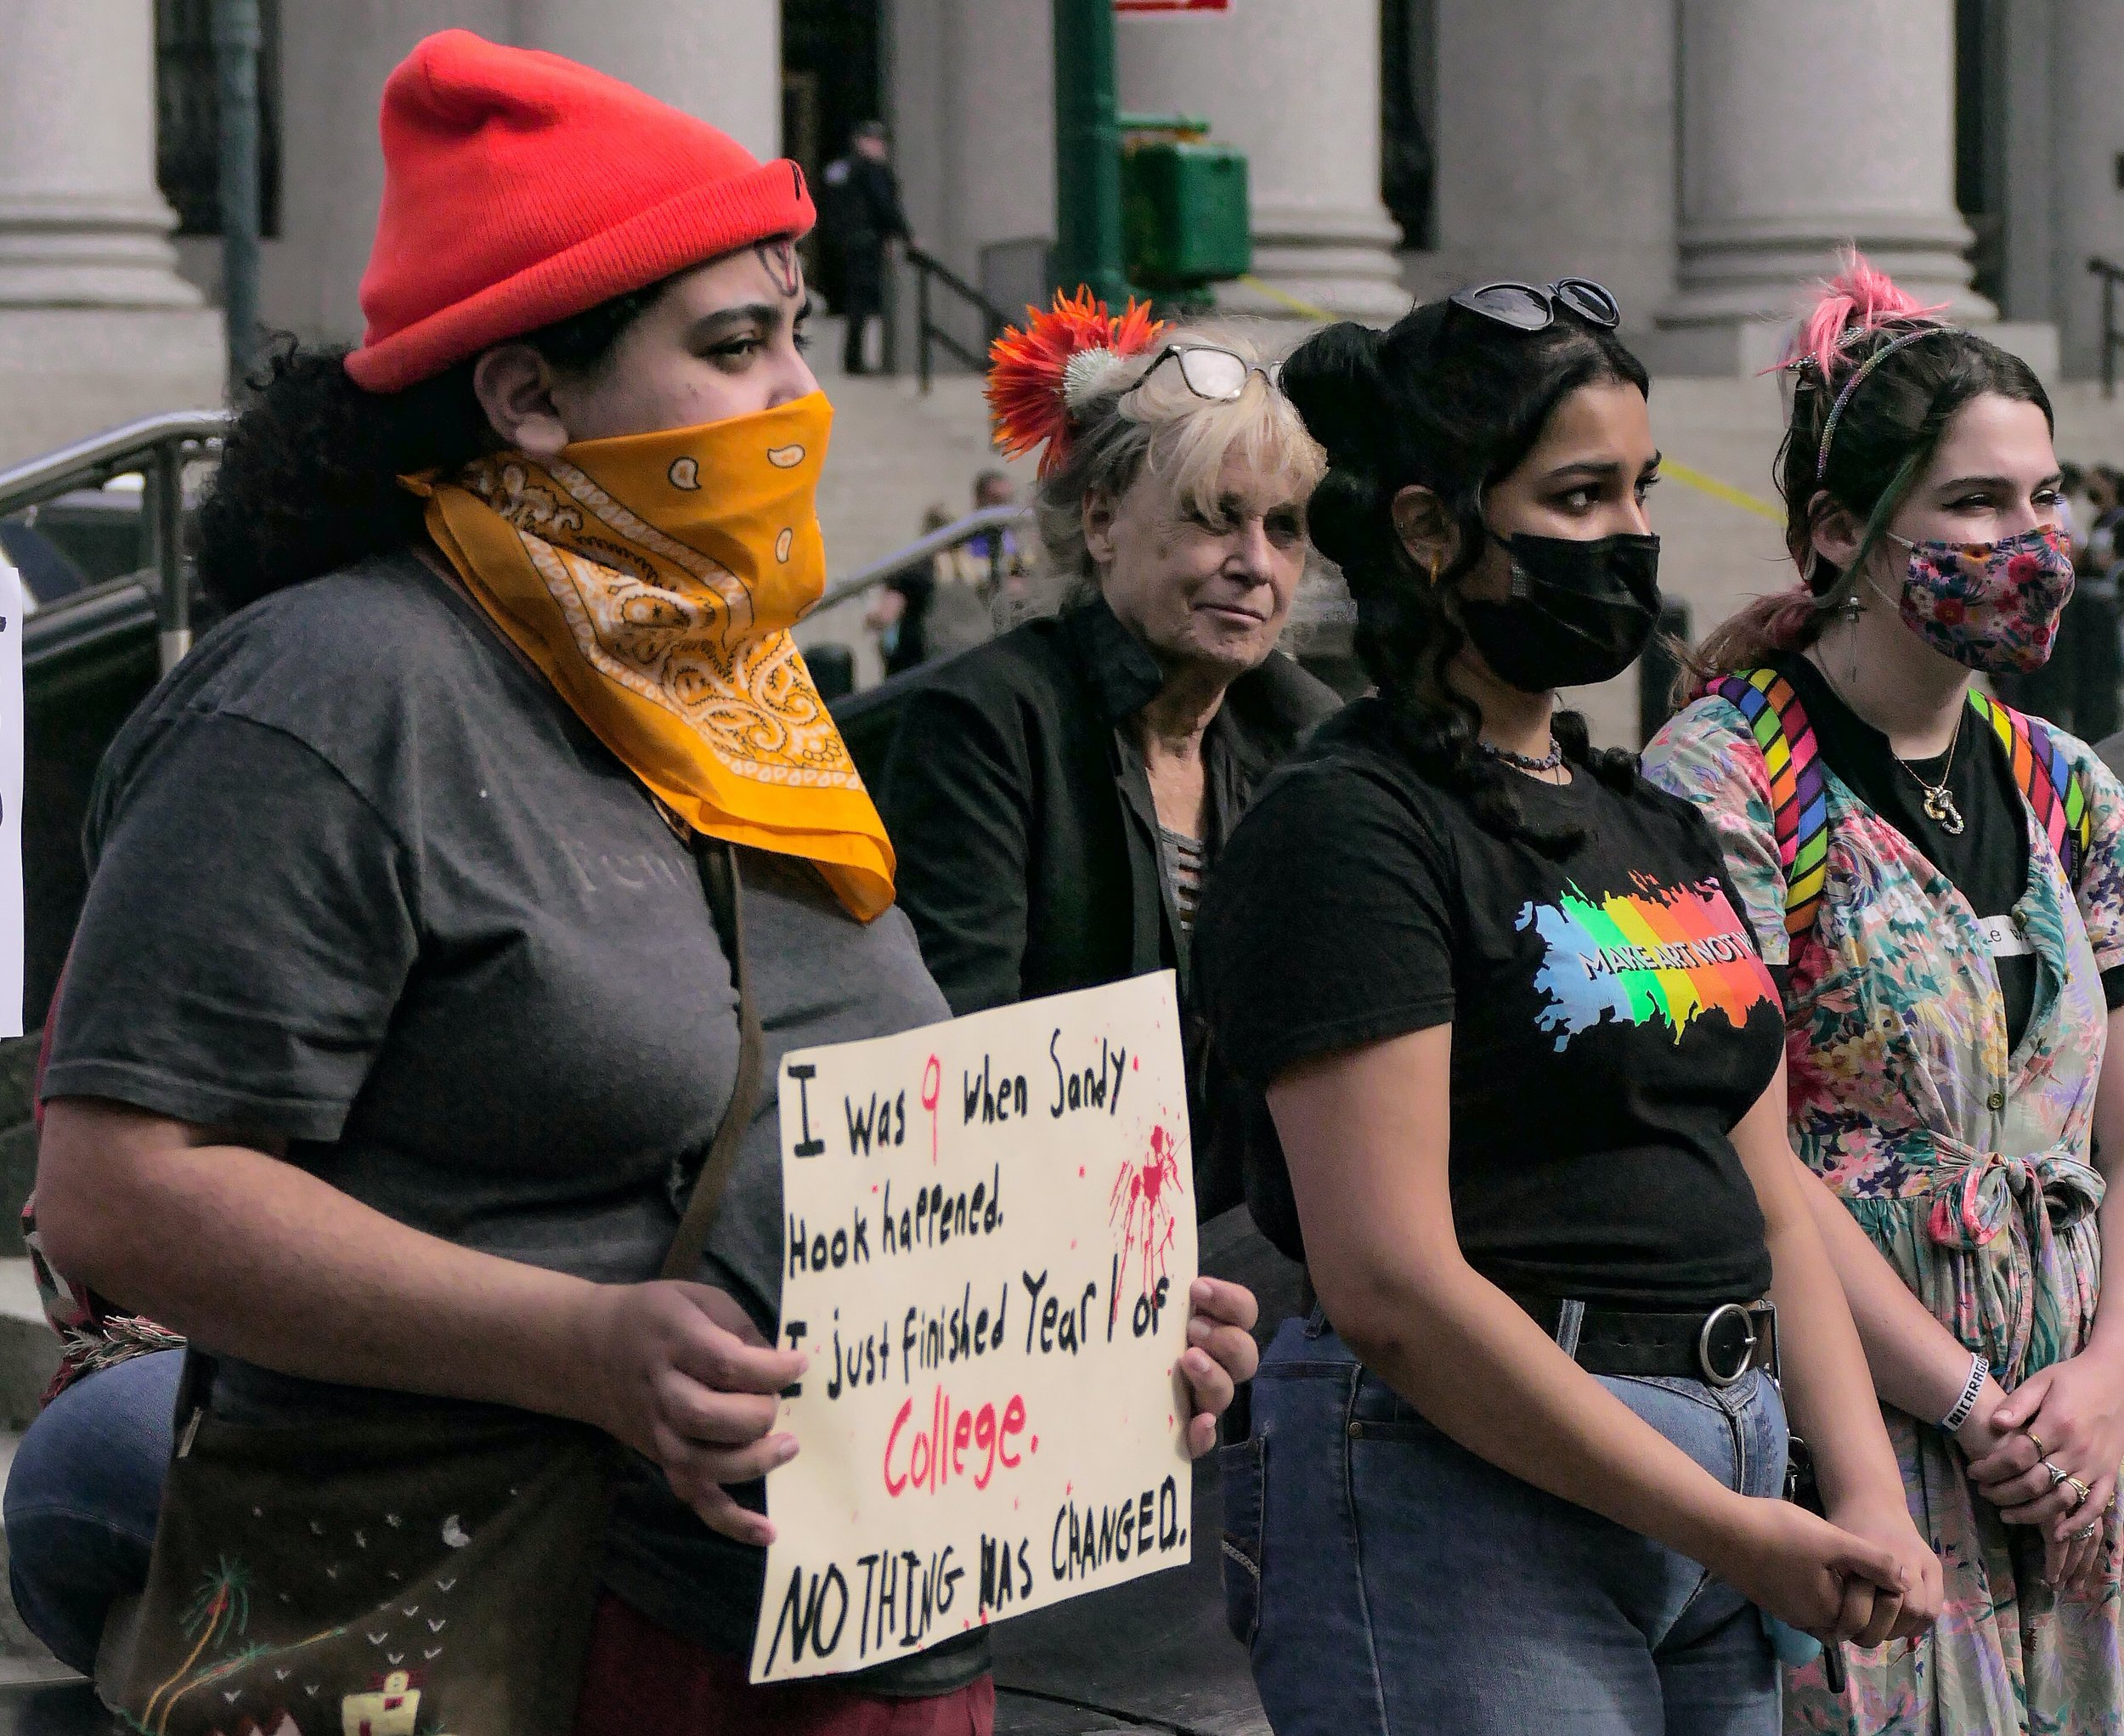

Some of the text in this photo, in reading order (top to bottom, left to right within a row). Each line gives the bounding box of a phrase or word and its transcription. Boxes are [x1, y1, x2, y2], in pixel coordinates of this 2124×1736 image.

[1578, 945, 1662, 981] MAKE
[1653, 942, 1700, 970] ART
[1690, 932, 1747, 965] NOT
[787, 1064, 826, 1158] I
[921, 1053, 941, 1167] 9
[1050, 1027, 1127, 1119] Sandy
[788, 1161, 1004, 1280] Hook happened.
[827, 1306, 890, 1400] just
[902, 1281, 1008, 1385] finished
[1021, 1269, 1098, 1356] Year
[1132, 1275, 1171, 1337] of
[1947, 1352, 1988, 1428] NICARAGU
[884, 1382, 1039, 1498] College.
[978, 1532, 1034, 1618] HAS
[1051, 1473, 1188, 1582] CHANGED.
